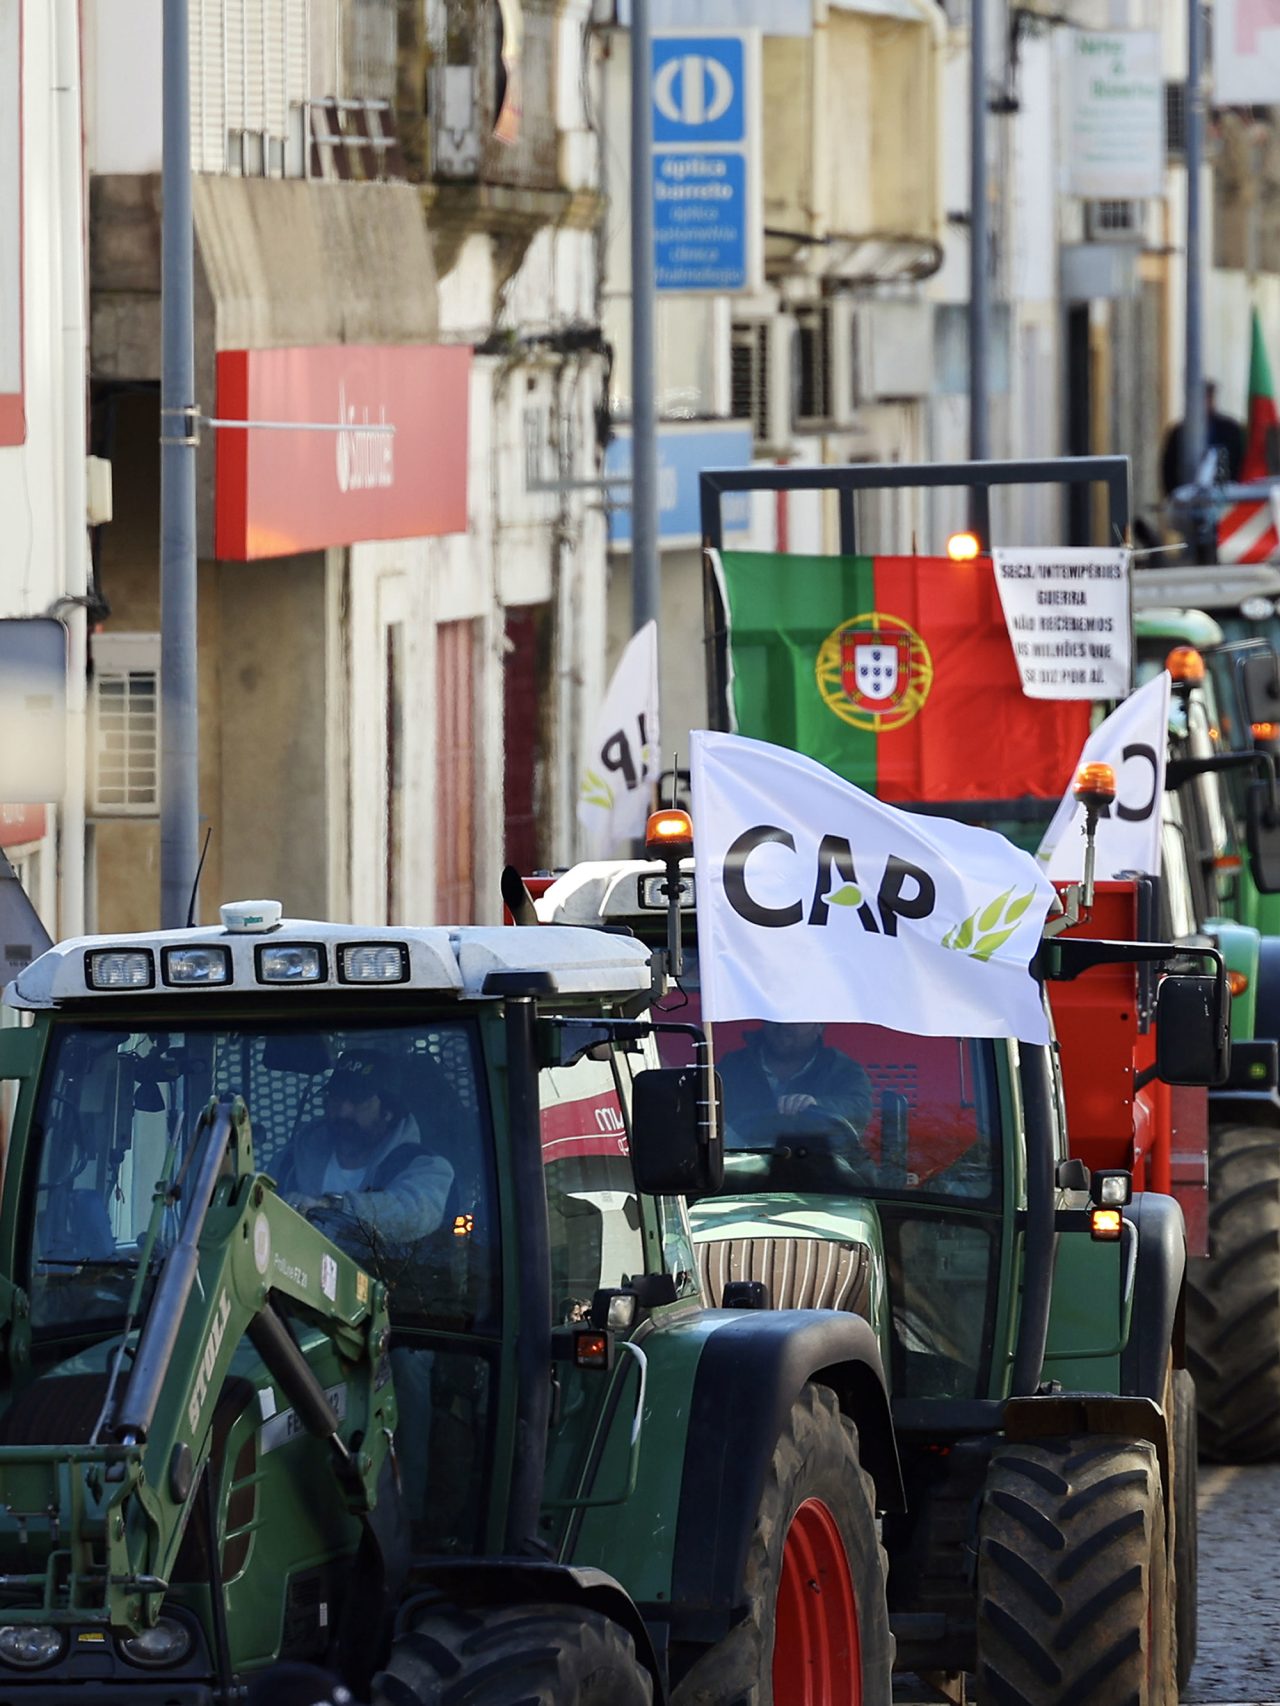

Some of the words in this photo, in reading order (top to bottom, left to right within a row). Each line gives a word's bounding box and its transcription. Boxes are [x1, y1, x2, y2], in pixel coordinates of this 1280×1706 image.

[1036, 589, 1087, 606] GUERRA
[1040, 616, 1113, 632] RECEBEMOS
[1033, 639, 1087, 658] MILHÕES
[1089, 643, 1112, 659] QUE
[722, 824, 936, 937] CAP
[188, 1286, 231, 1435] STOLL
